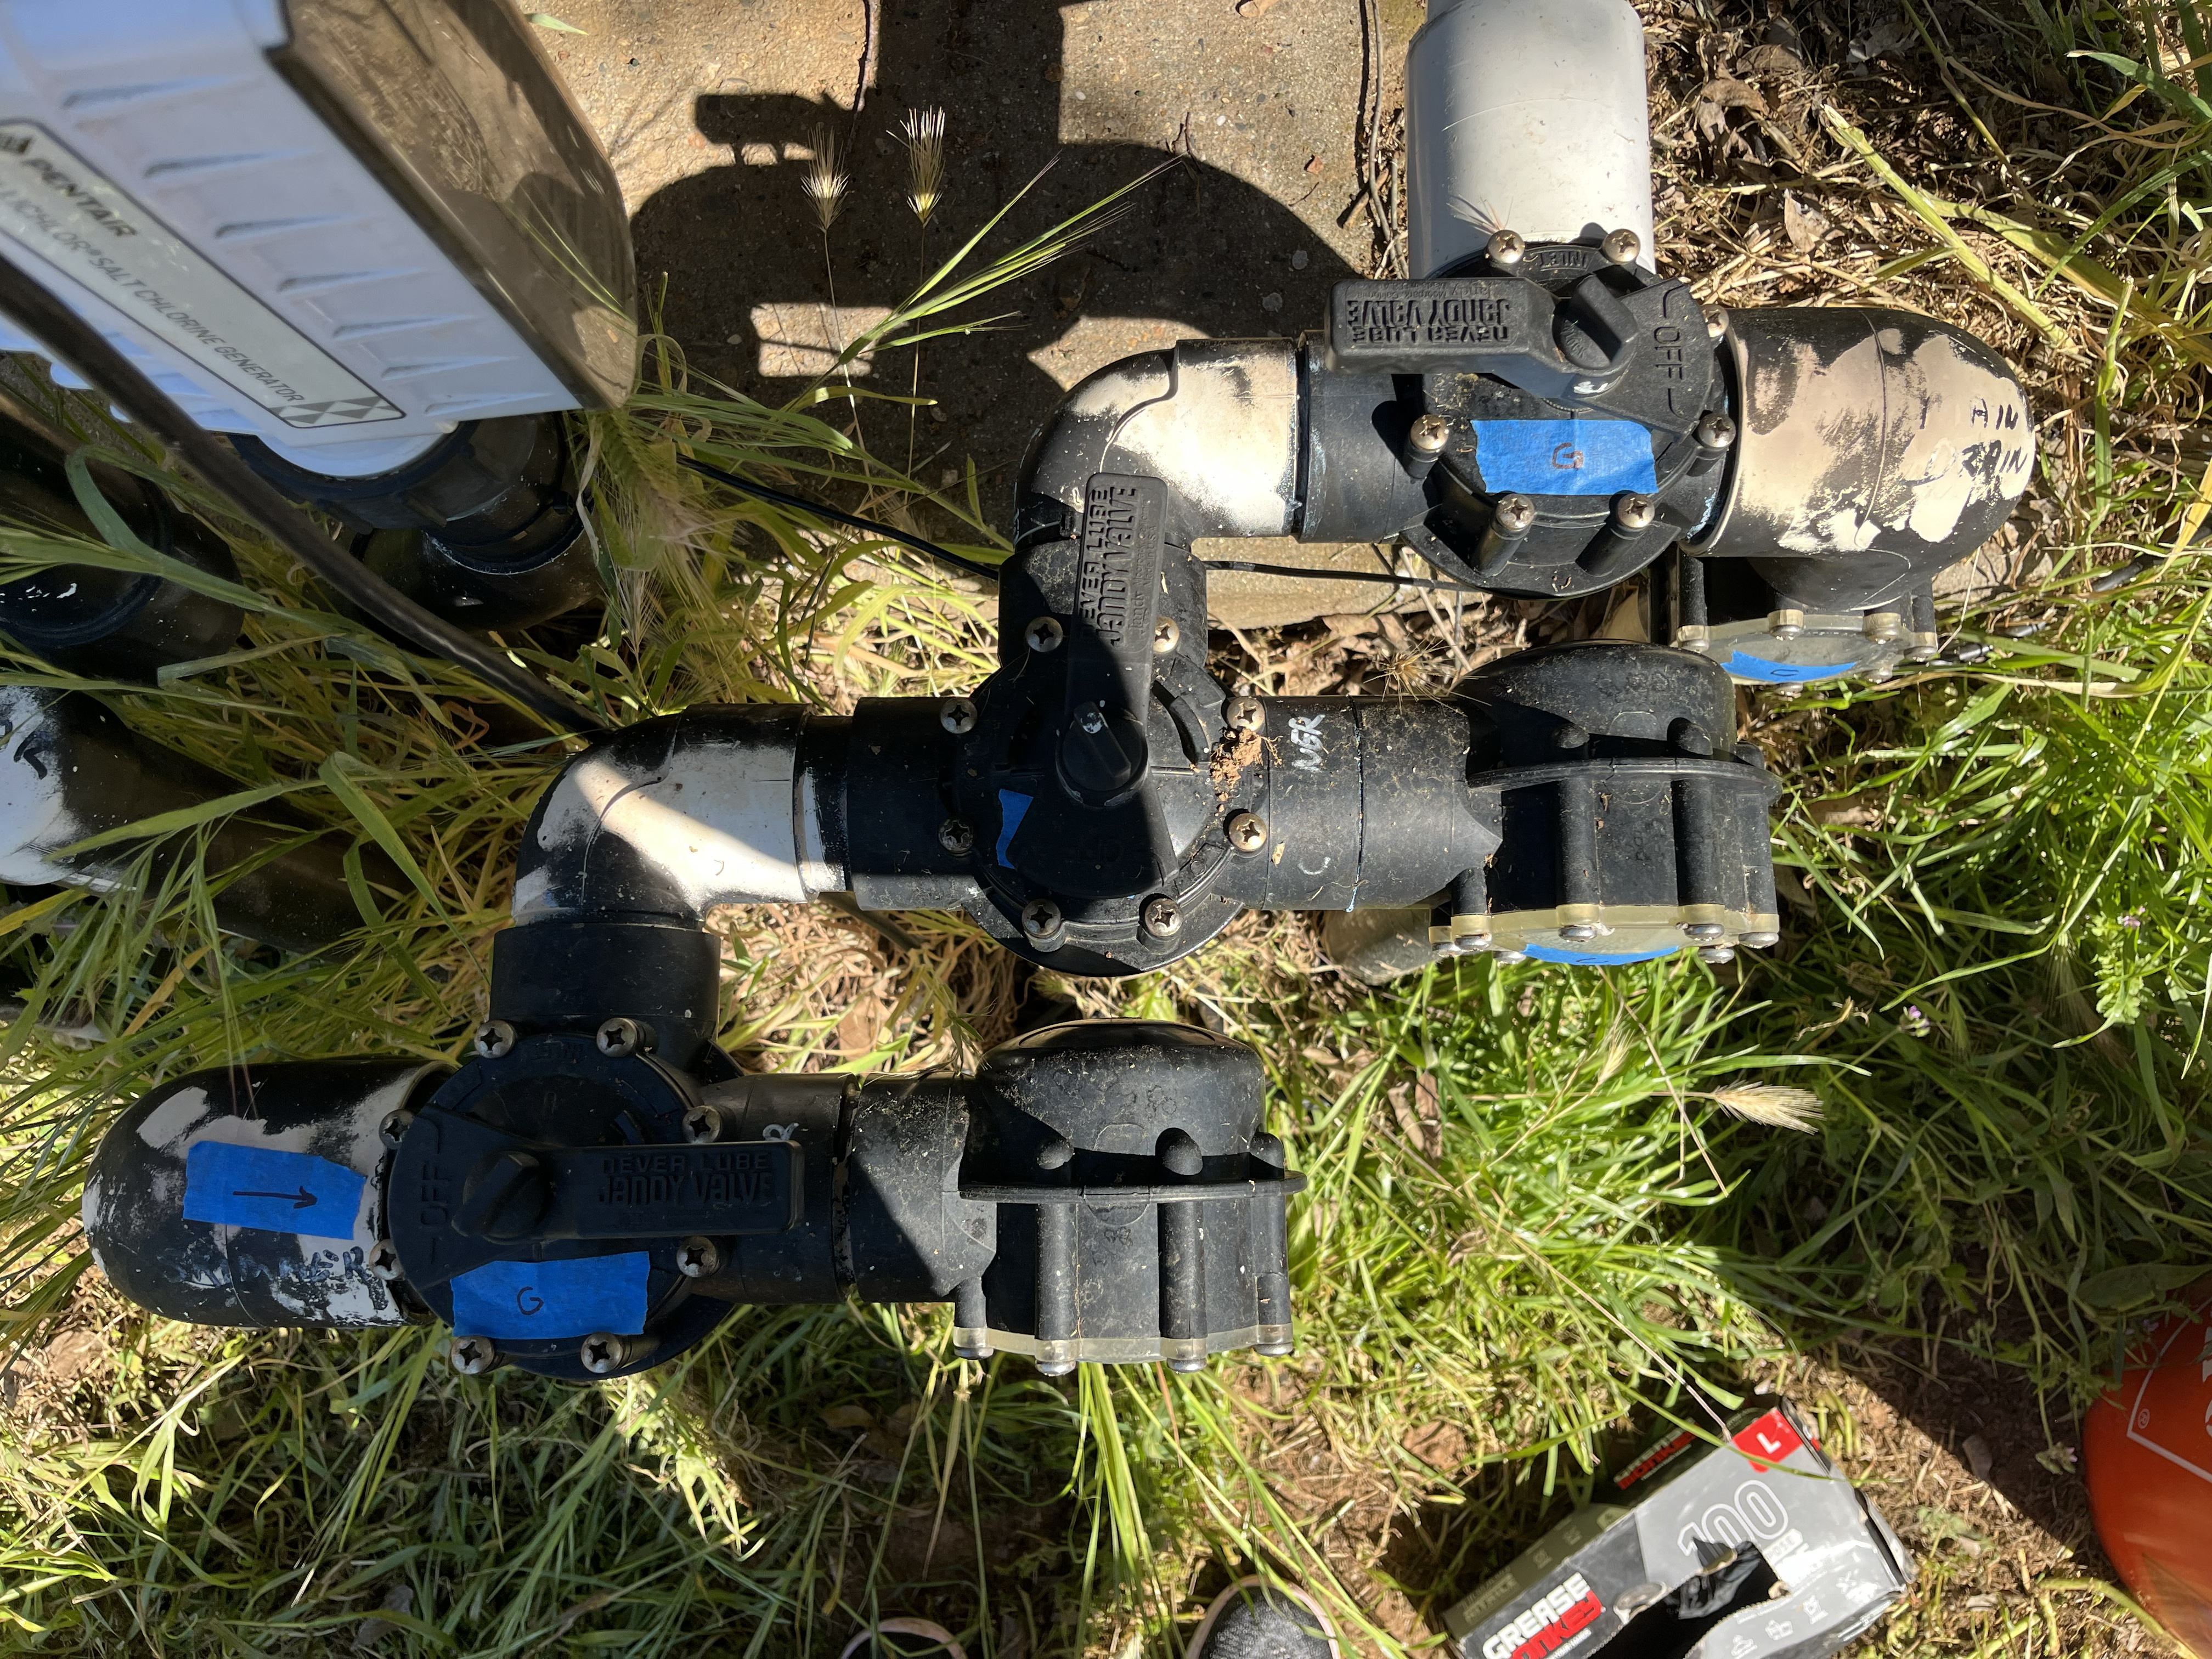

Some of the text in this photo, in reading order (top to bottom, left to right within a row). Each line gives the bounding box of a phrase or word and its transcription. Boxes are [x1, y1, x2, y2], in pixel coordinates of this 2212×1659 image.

[23, 158, 137, 238] PENTAIR
[88, 257, 147, 287] SALT
[134, 289, 226, 345] CHLORINE
[214, 346, 304, 402] GENERATOR
[1352, 326, 1418, 345] LUBE
[1654, 326, 1683, 380] OFF
[1551, 442, 1584, 471] G
[1086, 488, 1108, 551] LUBE
[699, 1151, 773, 1172] LUBE
[420, 1161, 452, 1225] OFF
[516, 1285, 545, 1316] G
[1756, 1432, 1782, 1454] L
[1482, 1572, 1590, 1659] GREASE
